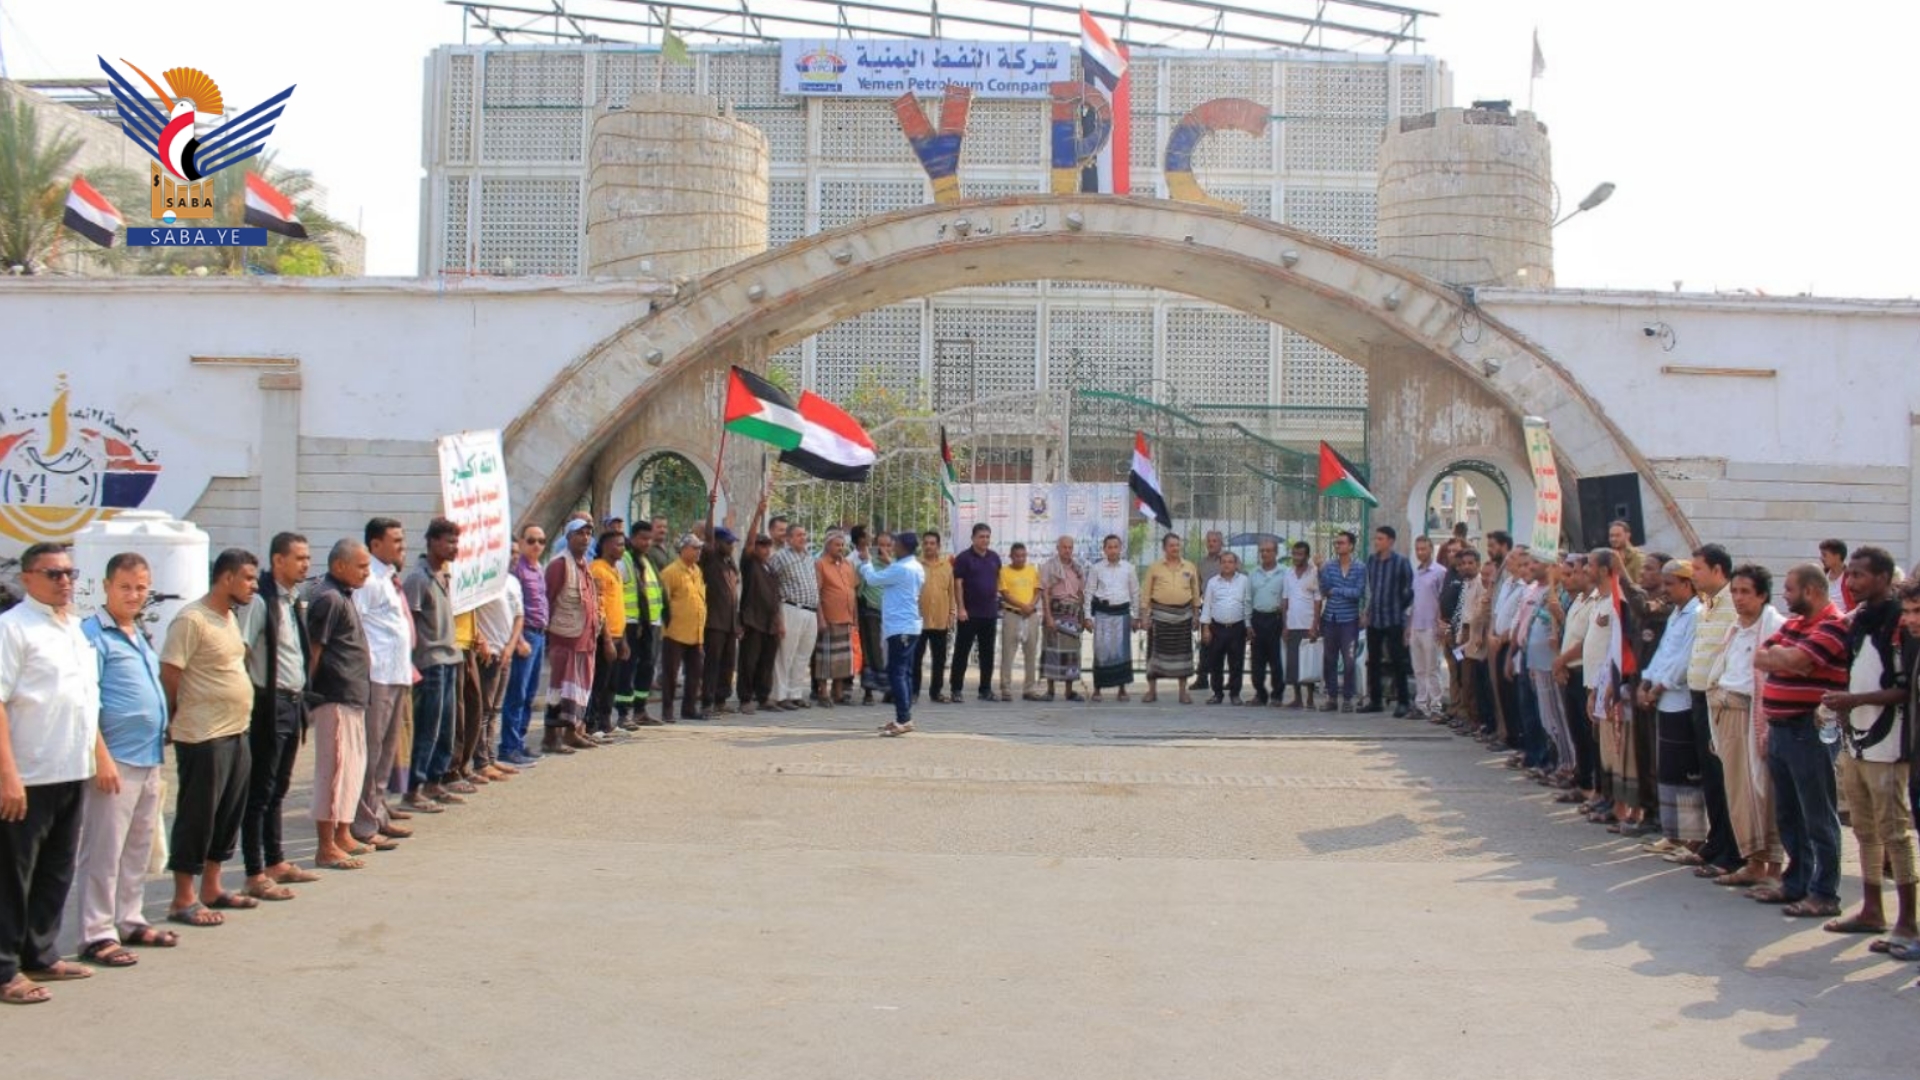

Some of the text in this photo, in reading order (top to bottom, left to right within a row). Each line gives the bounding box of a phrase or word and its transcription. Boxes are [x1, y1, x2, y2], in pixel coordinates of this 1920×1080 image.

[856, 46, 1058, 75] شركة النفط اليمنية
[857, 77, 904, 91] Yemen
[987, 79, 1048, 94] Compan
[891, 81, 1271, 214] YPC
